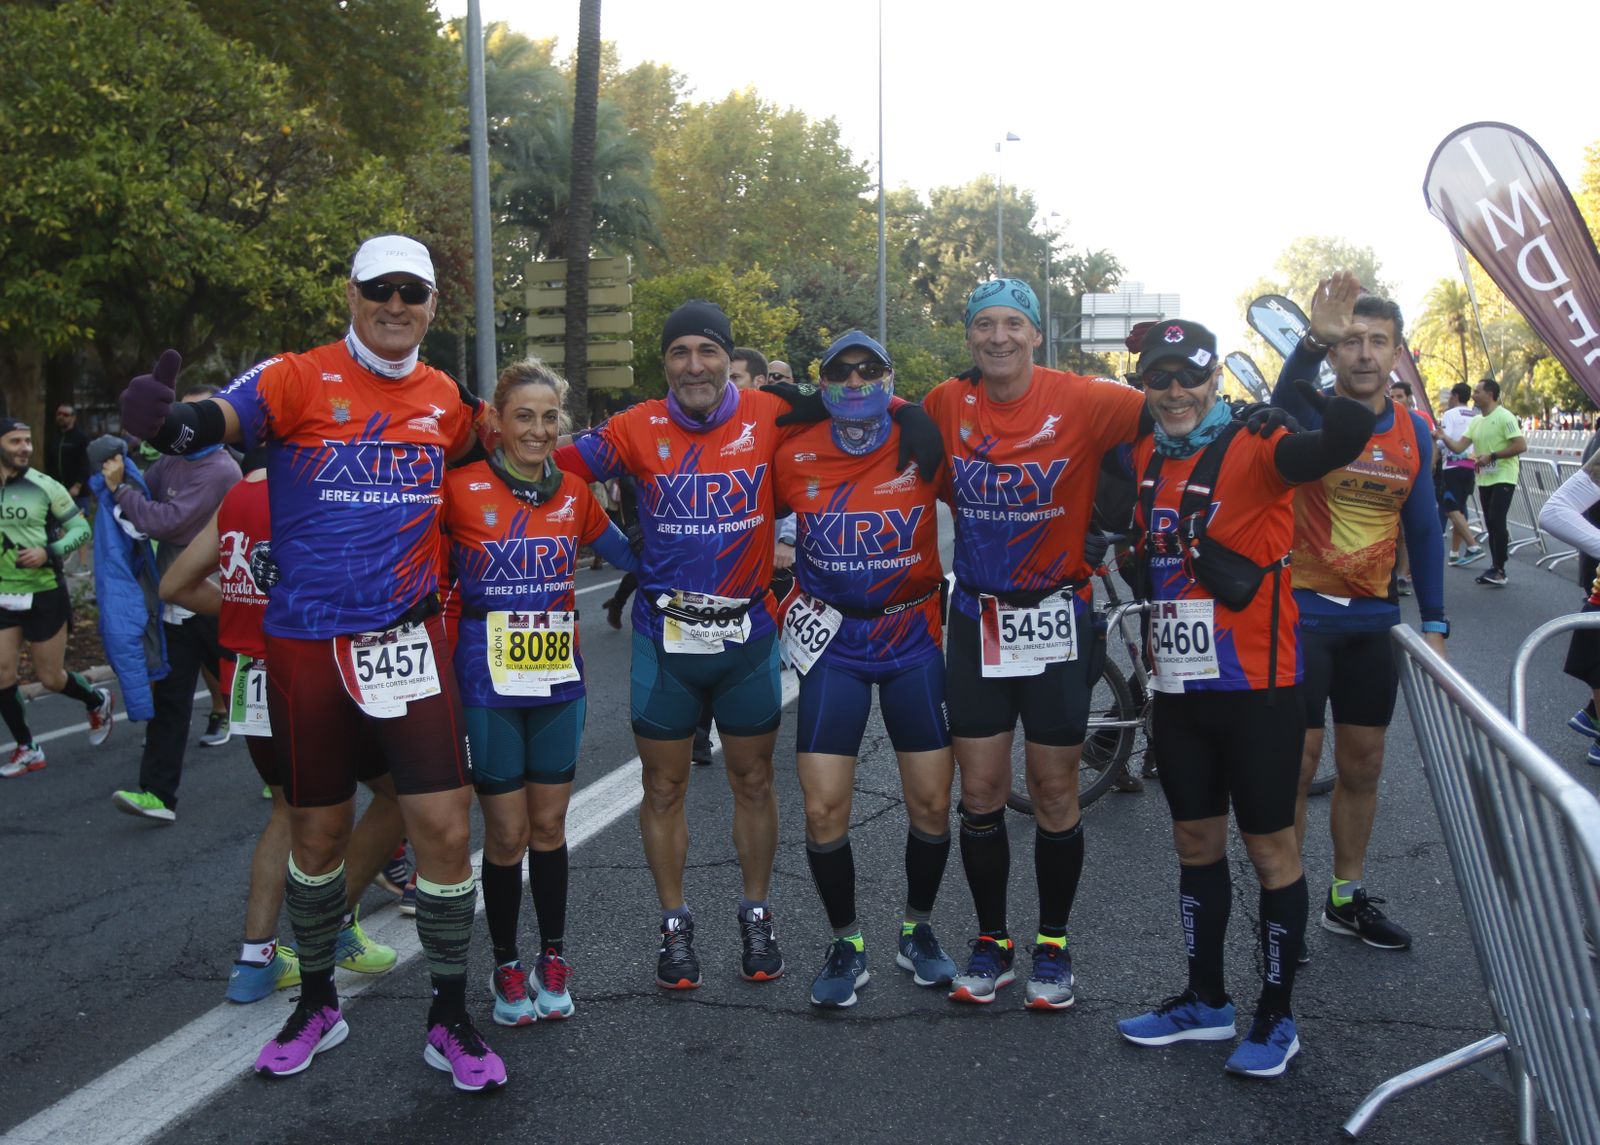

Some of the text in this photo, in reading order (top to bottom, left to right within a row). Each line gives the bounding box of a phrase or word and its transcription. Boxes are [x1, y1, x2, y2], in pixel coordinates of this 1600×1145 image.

[315, 440, 444, 488] XRY
[654, 463, 768, 519] XRY
[952, 455, 1070, 506] XRY
[319, 490, 359, 502] JEREZ
[363, 491, 380, 503] DE
[384, 492, 400, 504] LA
[657, 514, 764, 535] JEREZ DE LA FRONTERA
[976, 509, 991, 520] DE
[992, 510, 1006, 521] LA
[1008, 506, 1065, 522] FRONTERA
[802, 505, 925, 556] XRY
[481, 536, 578, 581] XRY
[831, 561, 848, 572] DE
[850, 559, 865, 571] LA
[867, 552, 922, 570] FRONTERA
[484, 585, 513, 596] JEREZ
[516, 585, 528, 595] DE
[530, 584, 543, 594] LA
[690, 629, 709, 638] DAVID
[786, 602, 830, 653] 5459
[1002, 609, 1072, 643] 5458
[1152, 621, 1209, 655] 5460
[356, 642, 428, 683] 5457
[509, 631, 570, 662] 8088
[1023, 643, 1045, 651] JIMENEZ
[360, 675, 435, 691] CLEMENTE CORTES HERRERA
